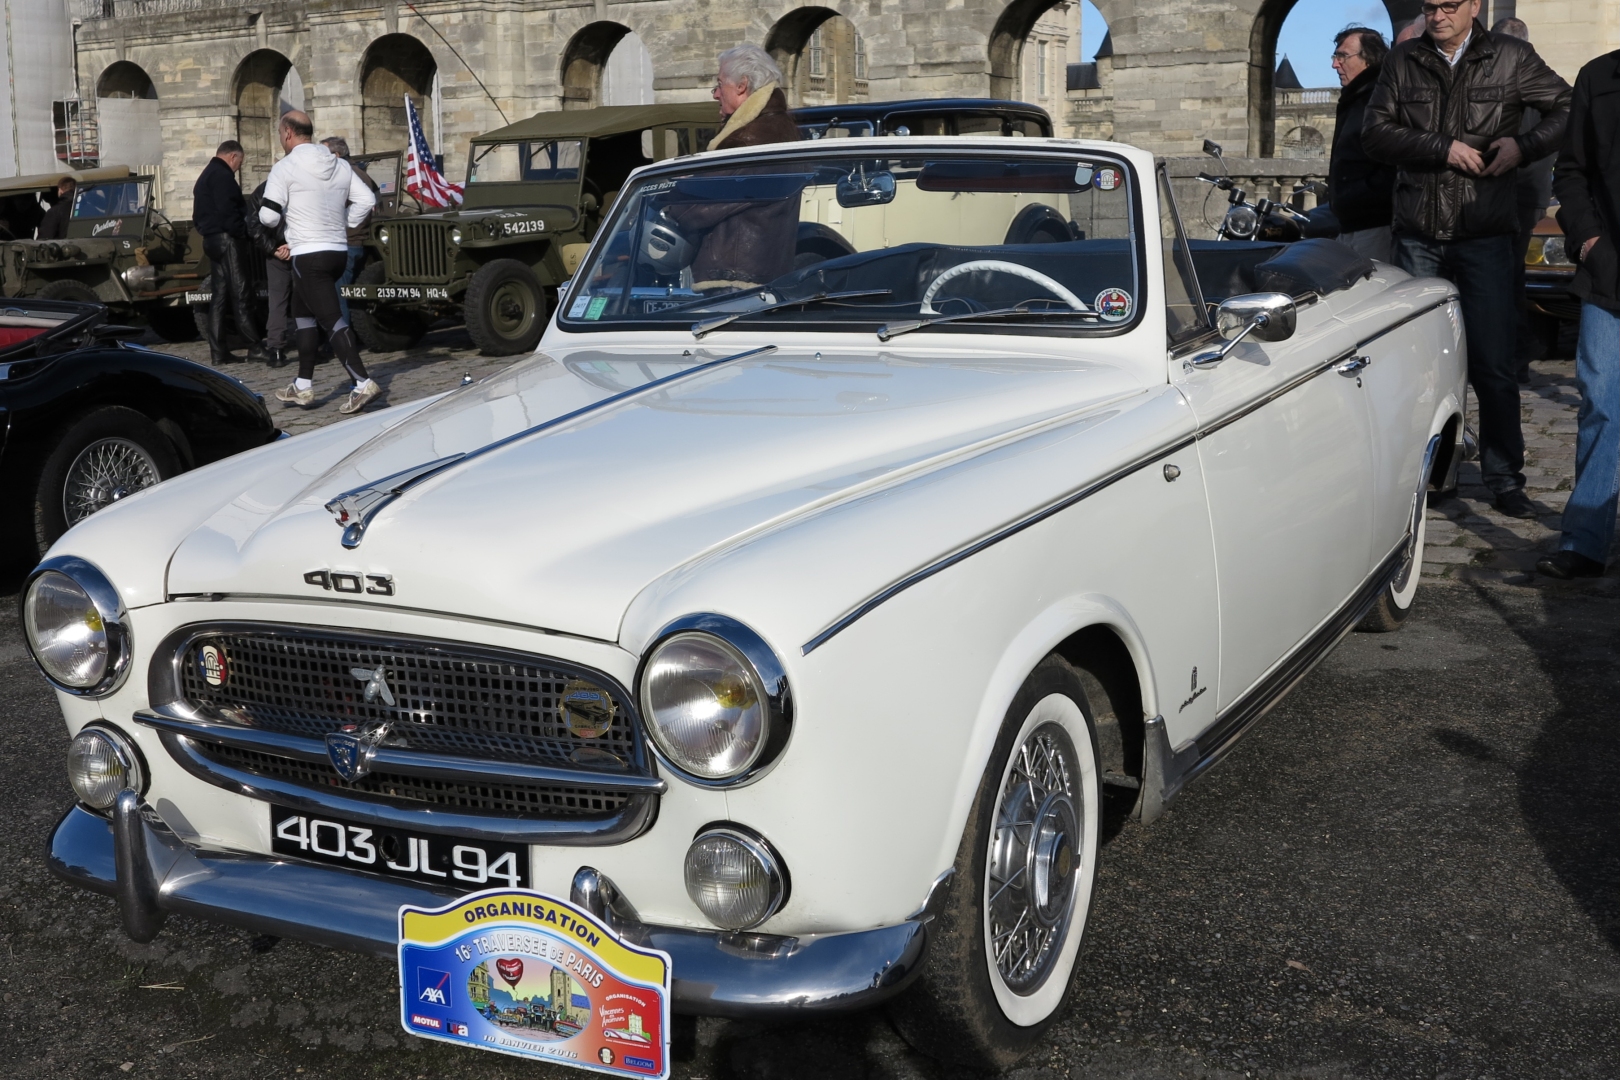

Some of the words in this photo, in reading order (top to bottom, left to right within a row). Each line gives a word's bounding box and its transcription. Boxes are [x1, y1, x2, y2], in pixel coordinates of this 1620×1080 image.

[123, 241, 130, 249] S
[340, 287, 367, 297] 3A-12C
[377, 288, 396, 298] 2139
[397, 288, 409, 298] ZM
[410, 288, 421, 298] 94
[426, 288, 448, 298] HQ-4
[303, 568, 396, 596] 403
[570, 691, 600, 700] 403
[276, 816, 376, 864] 403
[386, 837, 447, 878] JL
[452, 845, 522, 888] 94
[464, 901, 601, 948] ORGANISATION
[472, 933, 548, 958] TRAVERSEE
[550, 946, 565, 964] DE
[565, 951, 605, 989] PARIS
[419, 987, 446, 1005] AXA
[605, 993, 647, 1008] ORGANISATION
[413, 1015, 440, 1028] MOTUL
[483, 1034, 496, 1043] 10
[499, 1038, 545, 1052] JANVIER
[547, 1047, 578, 1059] 2016
[625, 1057, 653, 1068] BELGOM
